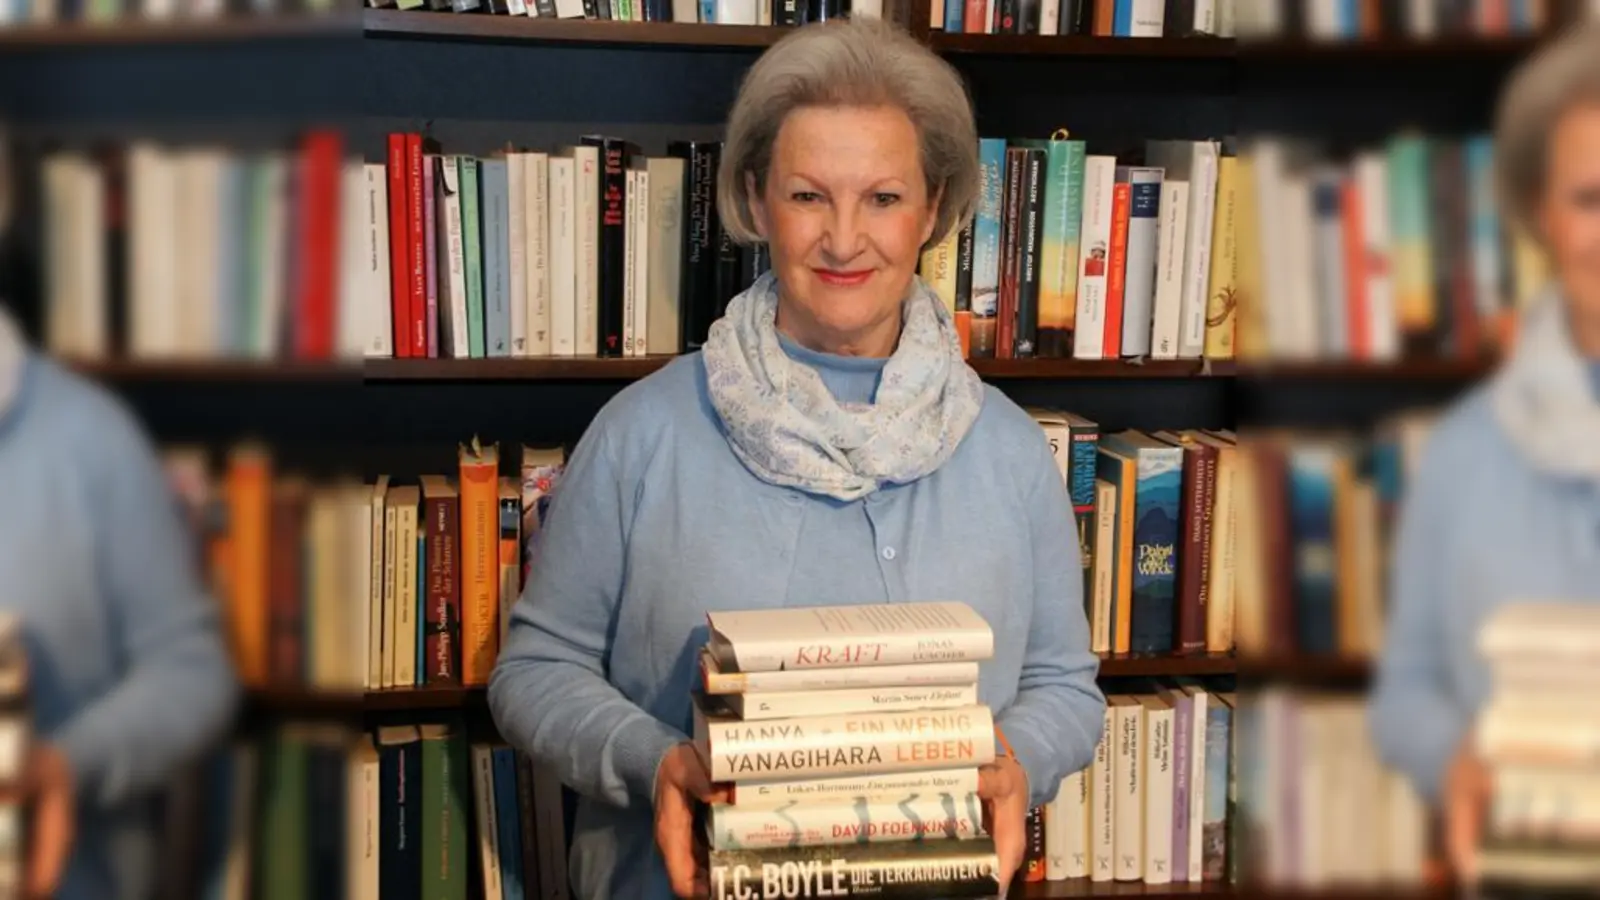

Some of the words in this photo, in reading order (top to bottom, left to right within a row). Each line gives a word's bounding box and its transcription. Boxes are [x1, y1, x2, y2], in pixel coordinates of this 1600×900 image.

[795, 642, 889, 665] KRAFT
[872, 694, 902, 704] Martin
[724, 724, 804, 744] HANYA
[845, 720, 885, 734] EIN
[893, 714, 972, 735] WENIG
[725, 745, 883, 774] YANAGIHARA
[896, 738, 974, 763] LEBEN
[786, 784, 814, 795] Lukas
[831, 821, 877, 839] DAVID
[881, 817, 969, 836] FOENKINOS
[711, 864, 760, 900] T.C.
[761, 857, 849, 900] BOYLE
[851, 867, 875, 886] DIE
